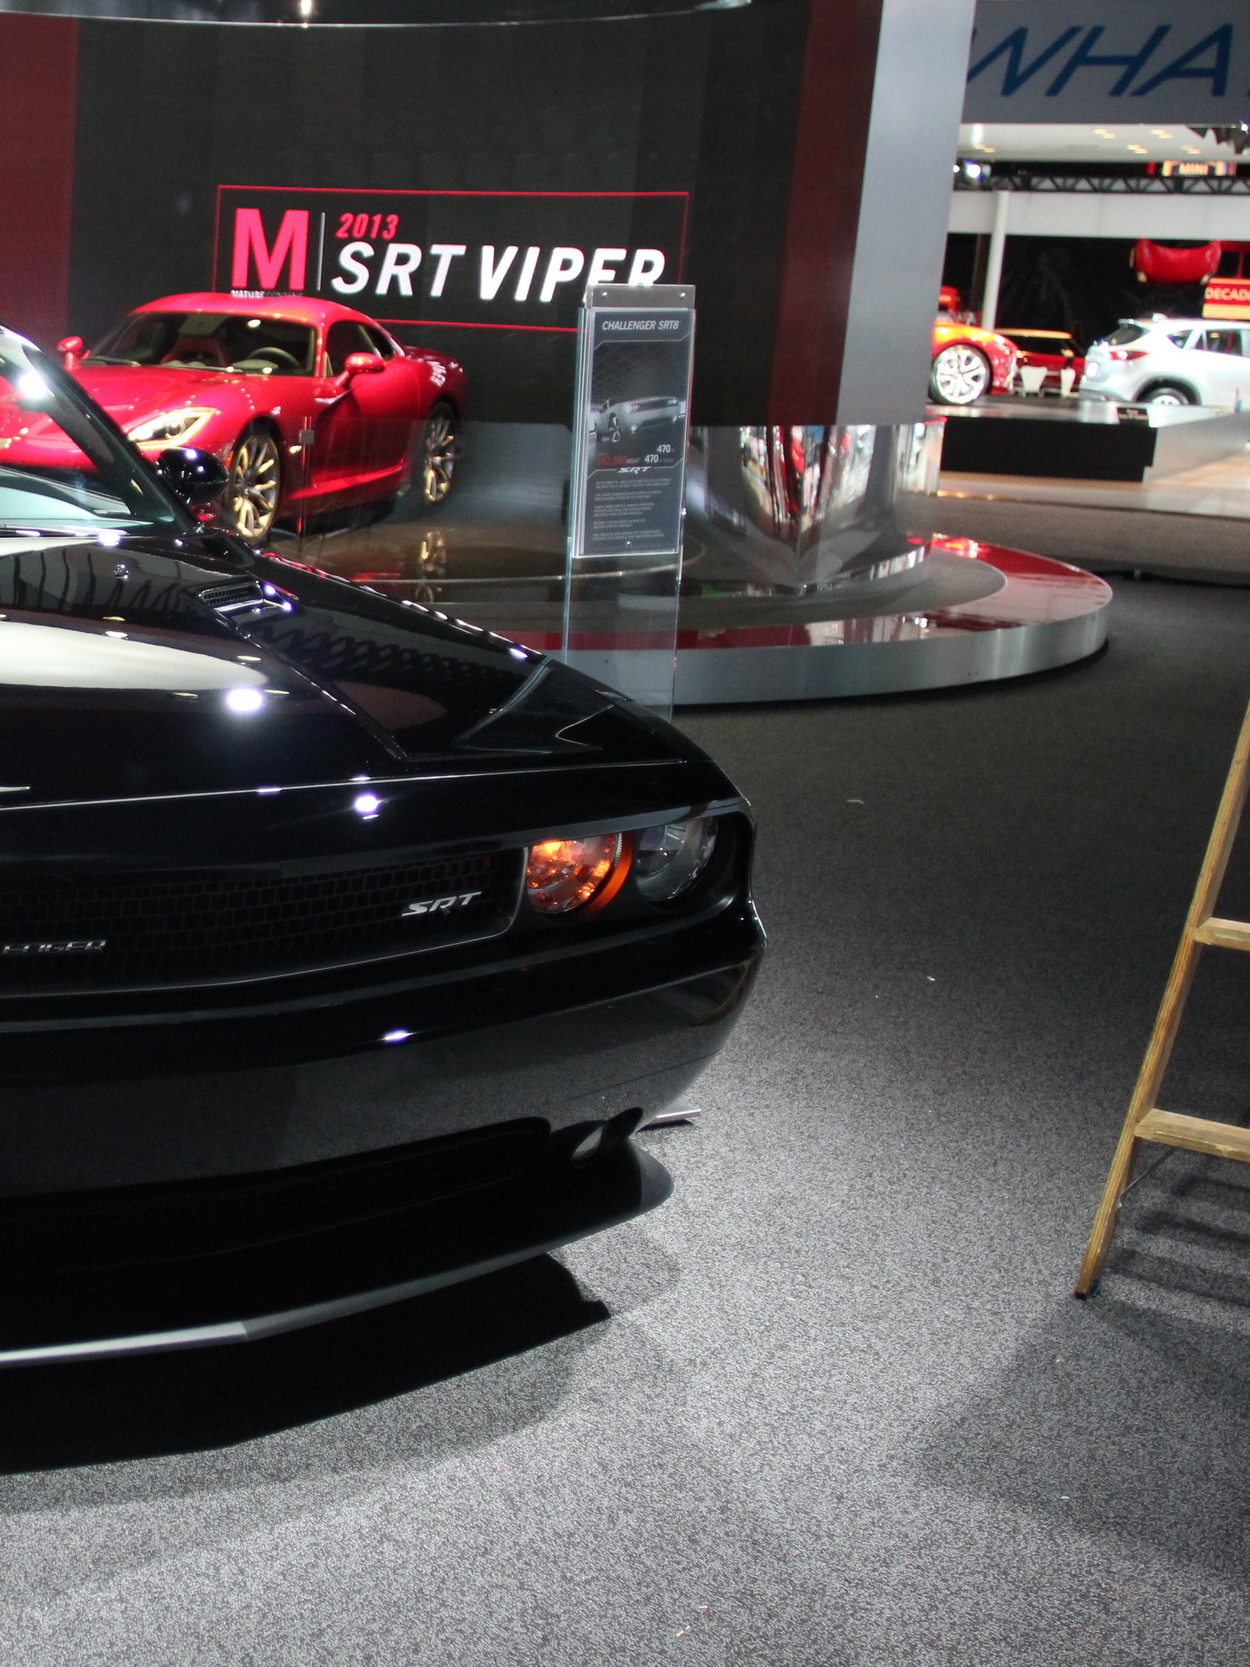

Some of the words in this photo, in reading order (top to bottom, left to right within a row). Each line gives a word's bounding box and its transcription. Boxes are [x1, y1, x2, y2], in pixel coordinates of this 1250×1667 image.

[967, 23, 1250, 97] WHA
[335, 213, 399, 239] 2013
[231, 208, 309, 290] M
[331, 241, 467, 296] SRT
[480, 245, 666, 302] VIPER
[602, 320, 656, 330] CHALLENGER
[658, 320, 680, 330] SRT8
[644, 454, 659, 463] 470
[656, 444, 671, 453] 470
[617, 466, 652, 474] SRT
[401, 891, 482, 916] SRT
